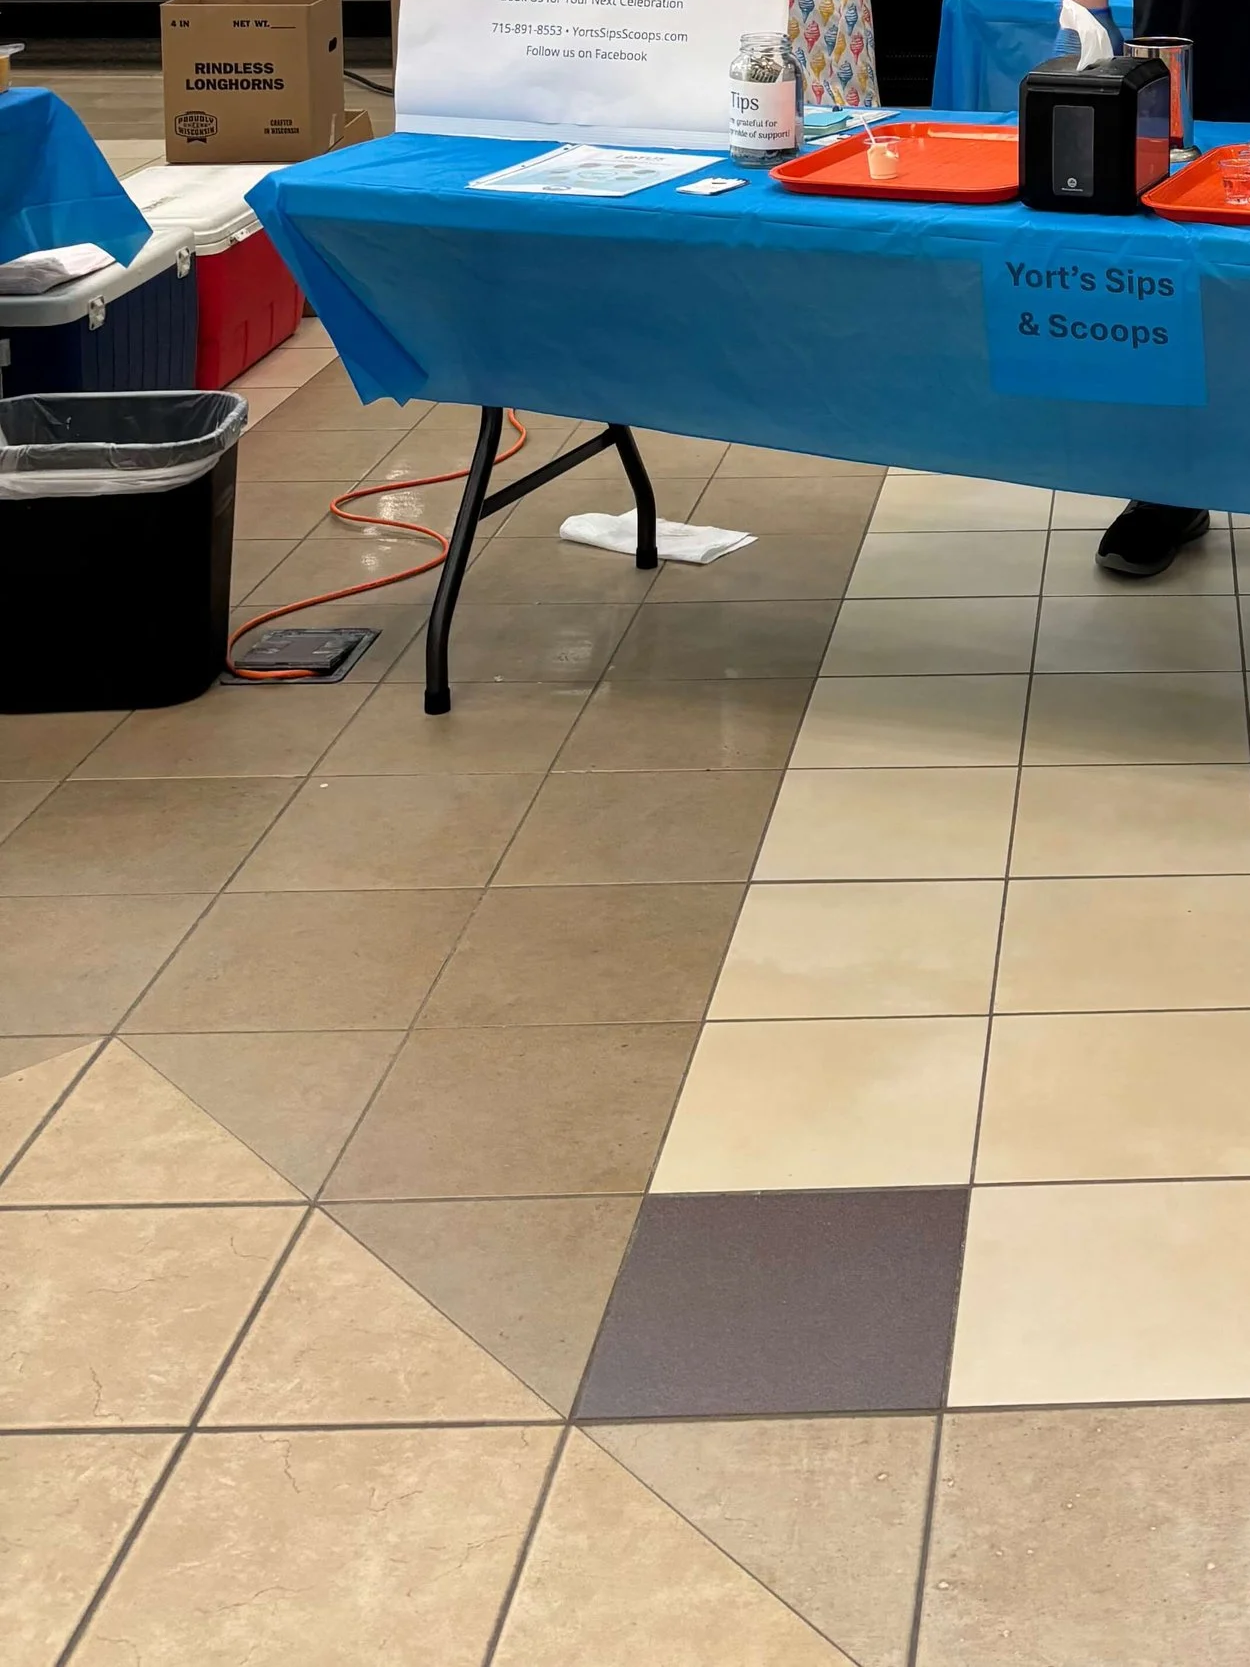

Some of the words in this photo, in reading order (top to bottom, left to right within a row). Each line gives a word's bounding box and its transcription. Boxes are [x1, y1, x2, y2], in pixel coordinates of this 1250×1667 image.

[492, 23, 562, 35] 715-891-8553
[573, 27, 687, 43] YortsSipsScoops.com
[527, 46, 560, 57] Follow
[578, 50, 592, 58] on
[596, 49, 647, 61] Facebook
[195, 63, 273, 74] RINDLESS
[186, 79, 284, 90] LONGHORNS
[730, 91, 760, 114] Tips
[736, 119, 764, 128] grateful
[765, 119, 778, 128] for
[749, 130, 756, 138] of
[758, 130, 791, 140] support!
[1006, 261, 1096, 292] Yort's
[1105, 267, 1175, 300] Sips
[1018, 311, 1040, 337] &
[1049, 313, 1169, 349] Scoops
